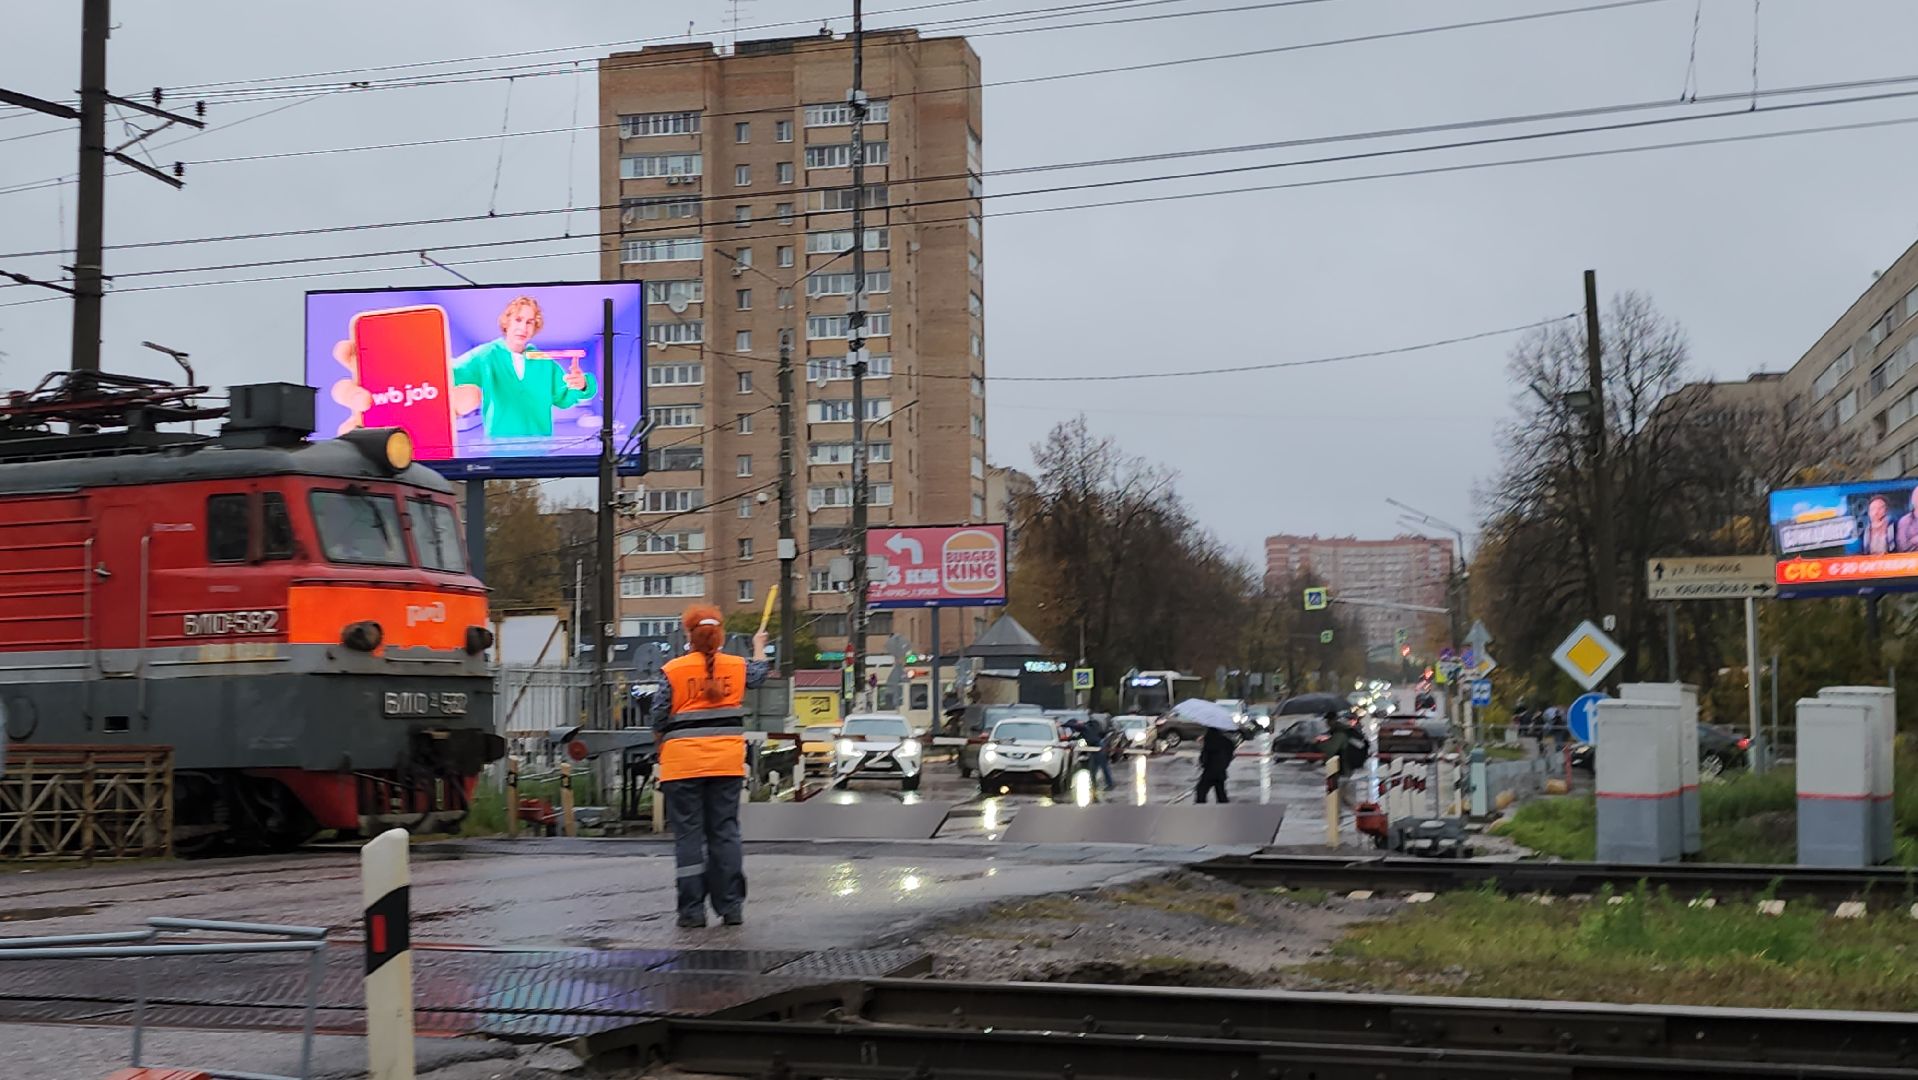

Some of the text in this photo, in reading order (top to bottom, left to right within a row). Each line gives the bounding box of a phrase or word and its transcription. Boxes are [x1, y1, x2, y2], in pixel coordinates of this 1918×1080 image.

[372, 382, 438, 407] wb job
[945, 551, 997, 562] BURGER
[945, 563, 997, 580] KING
[1784, 561, 1821, 581] СТС
